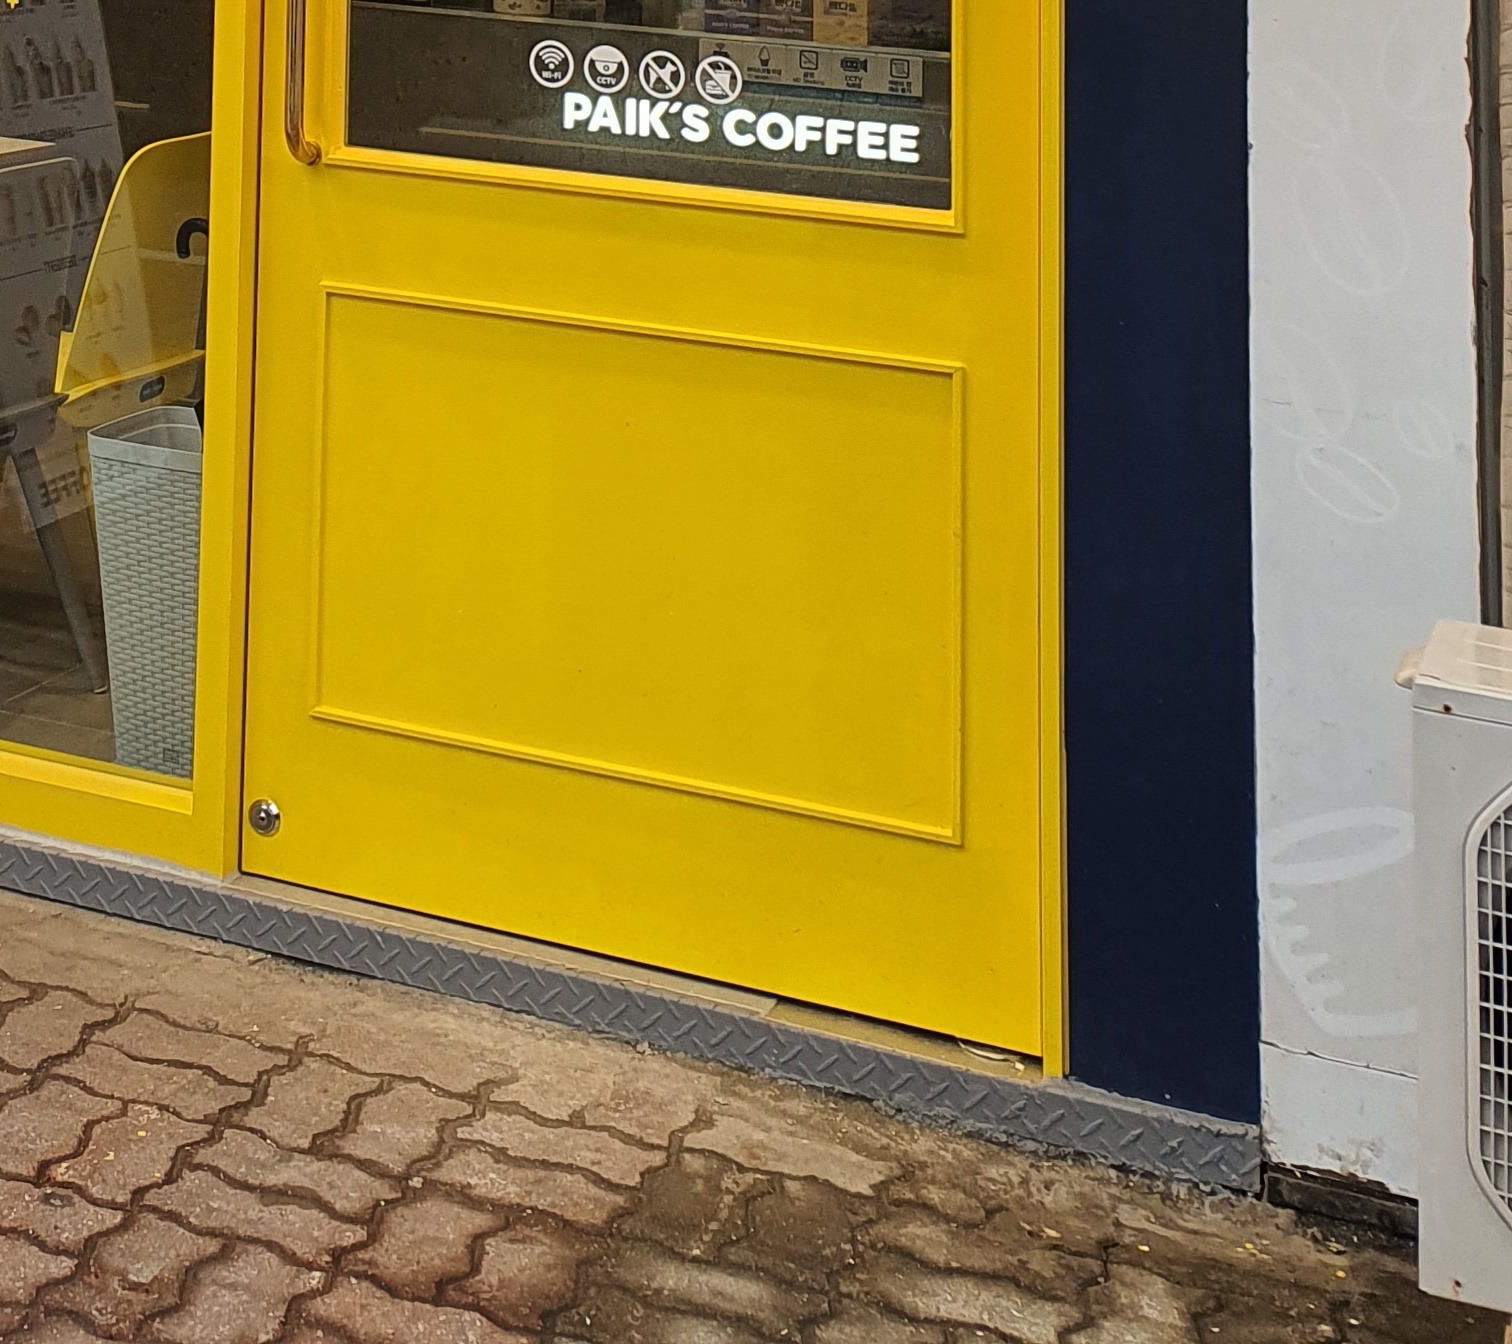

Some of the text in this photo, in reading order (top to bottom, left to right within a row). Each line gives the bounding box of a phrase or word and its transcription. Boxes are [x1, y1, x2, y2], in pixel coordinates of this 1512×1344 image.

[596, 76, 617, 85] CCTV
[562, 91, 921, 164] PAIK'S COFFEE
